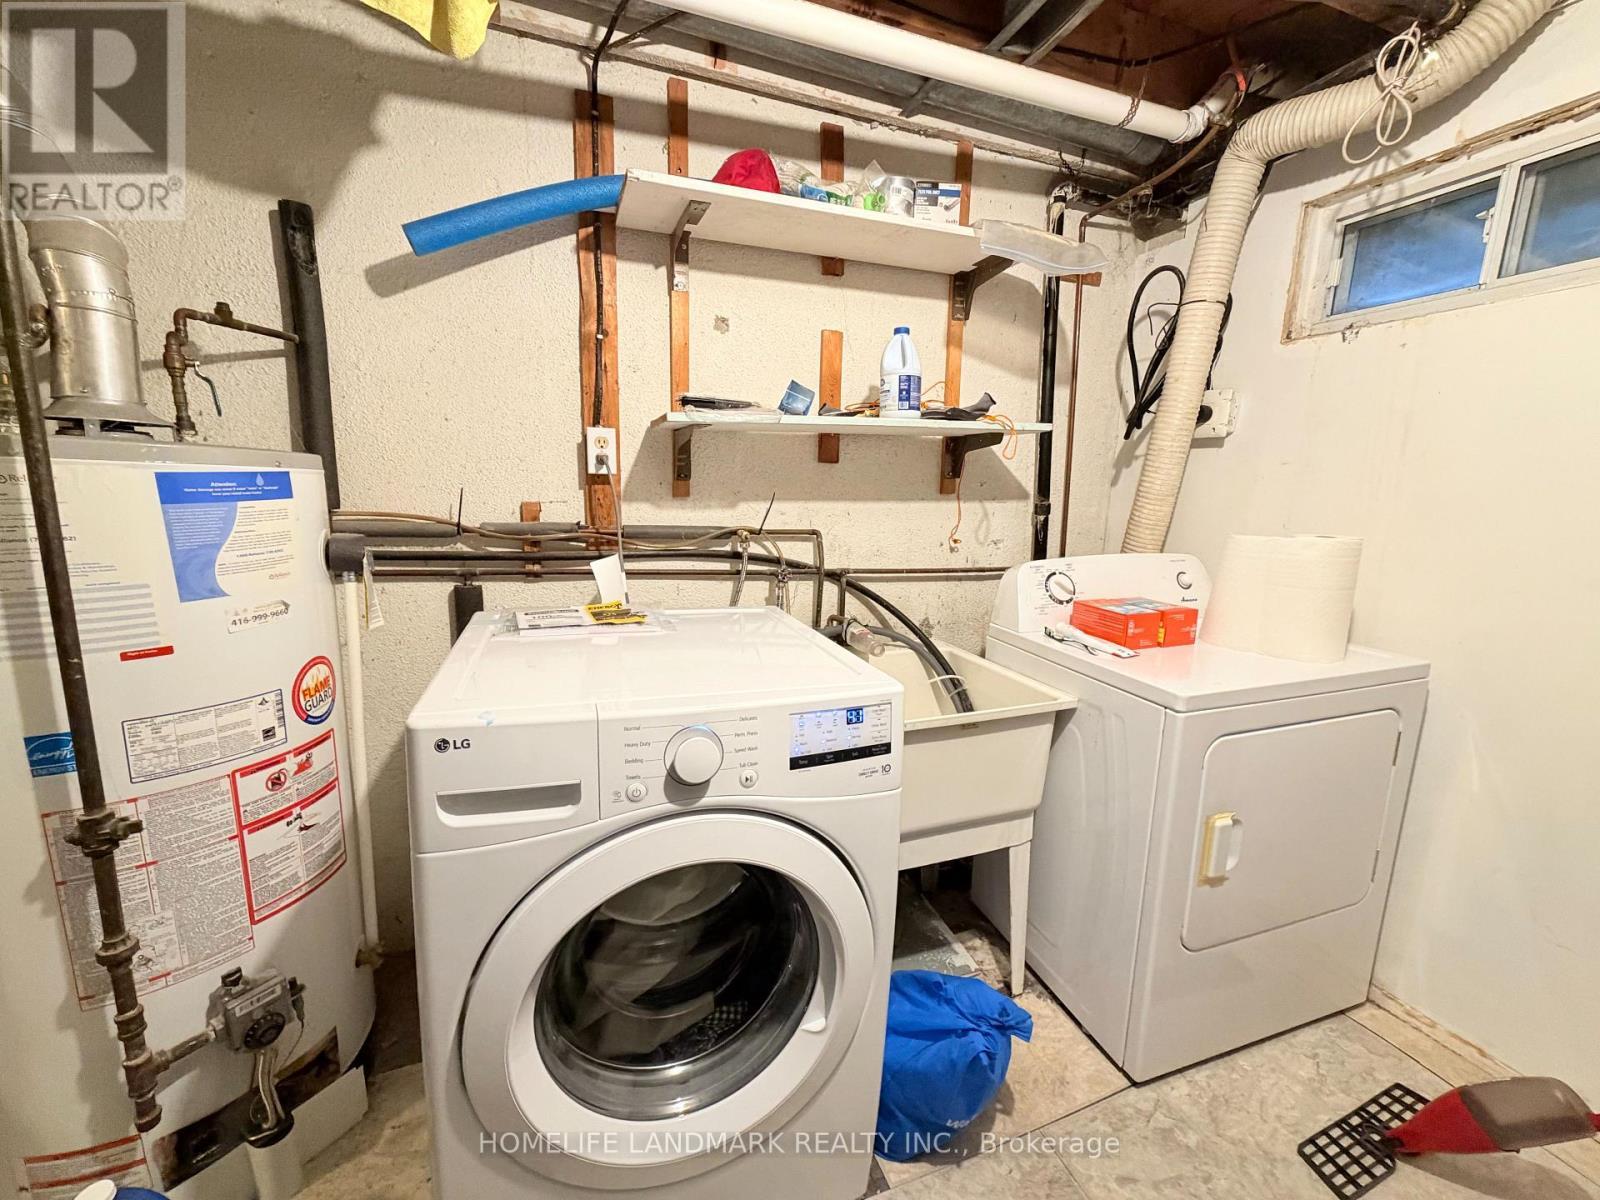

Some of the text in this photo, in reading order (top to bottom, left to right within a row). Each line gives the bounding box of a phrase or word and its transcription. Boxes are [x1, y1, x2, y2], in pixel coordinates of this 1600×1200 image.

[302, 675, 331, 702] FLAME
[304, 686, 333, 712] GUARD
[452, 738, 471, 750] LG
[624, 757, 644, 765] Bedding
